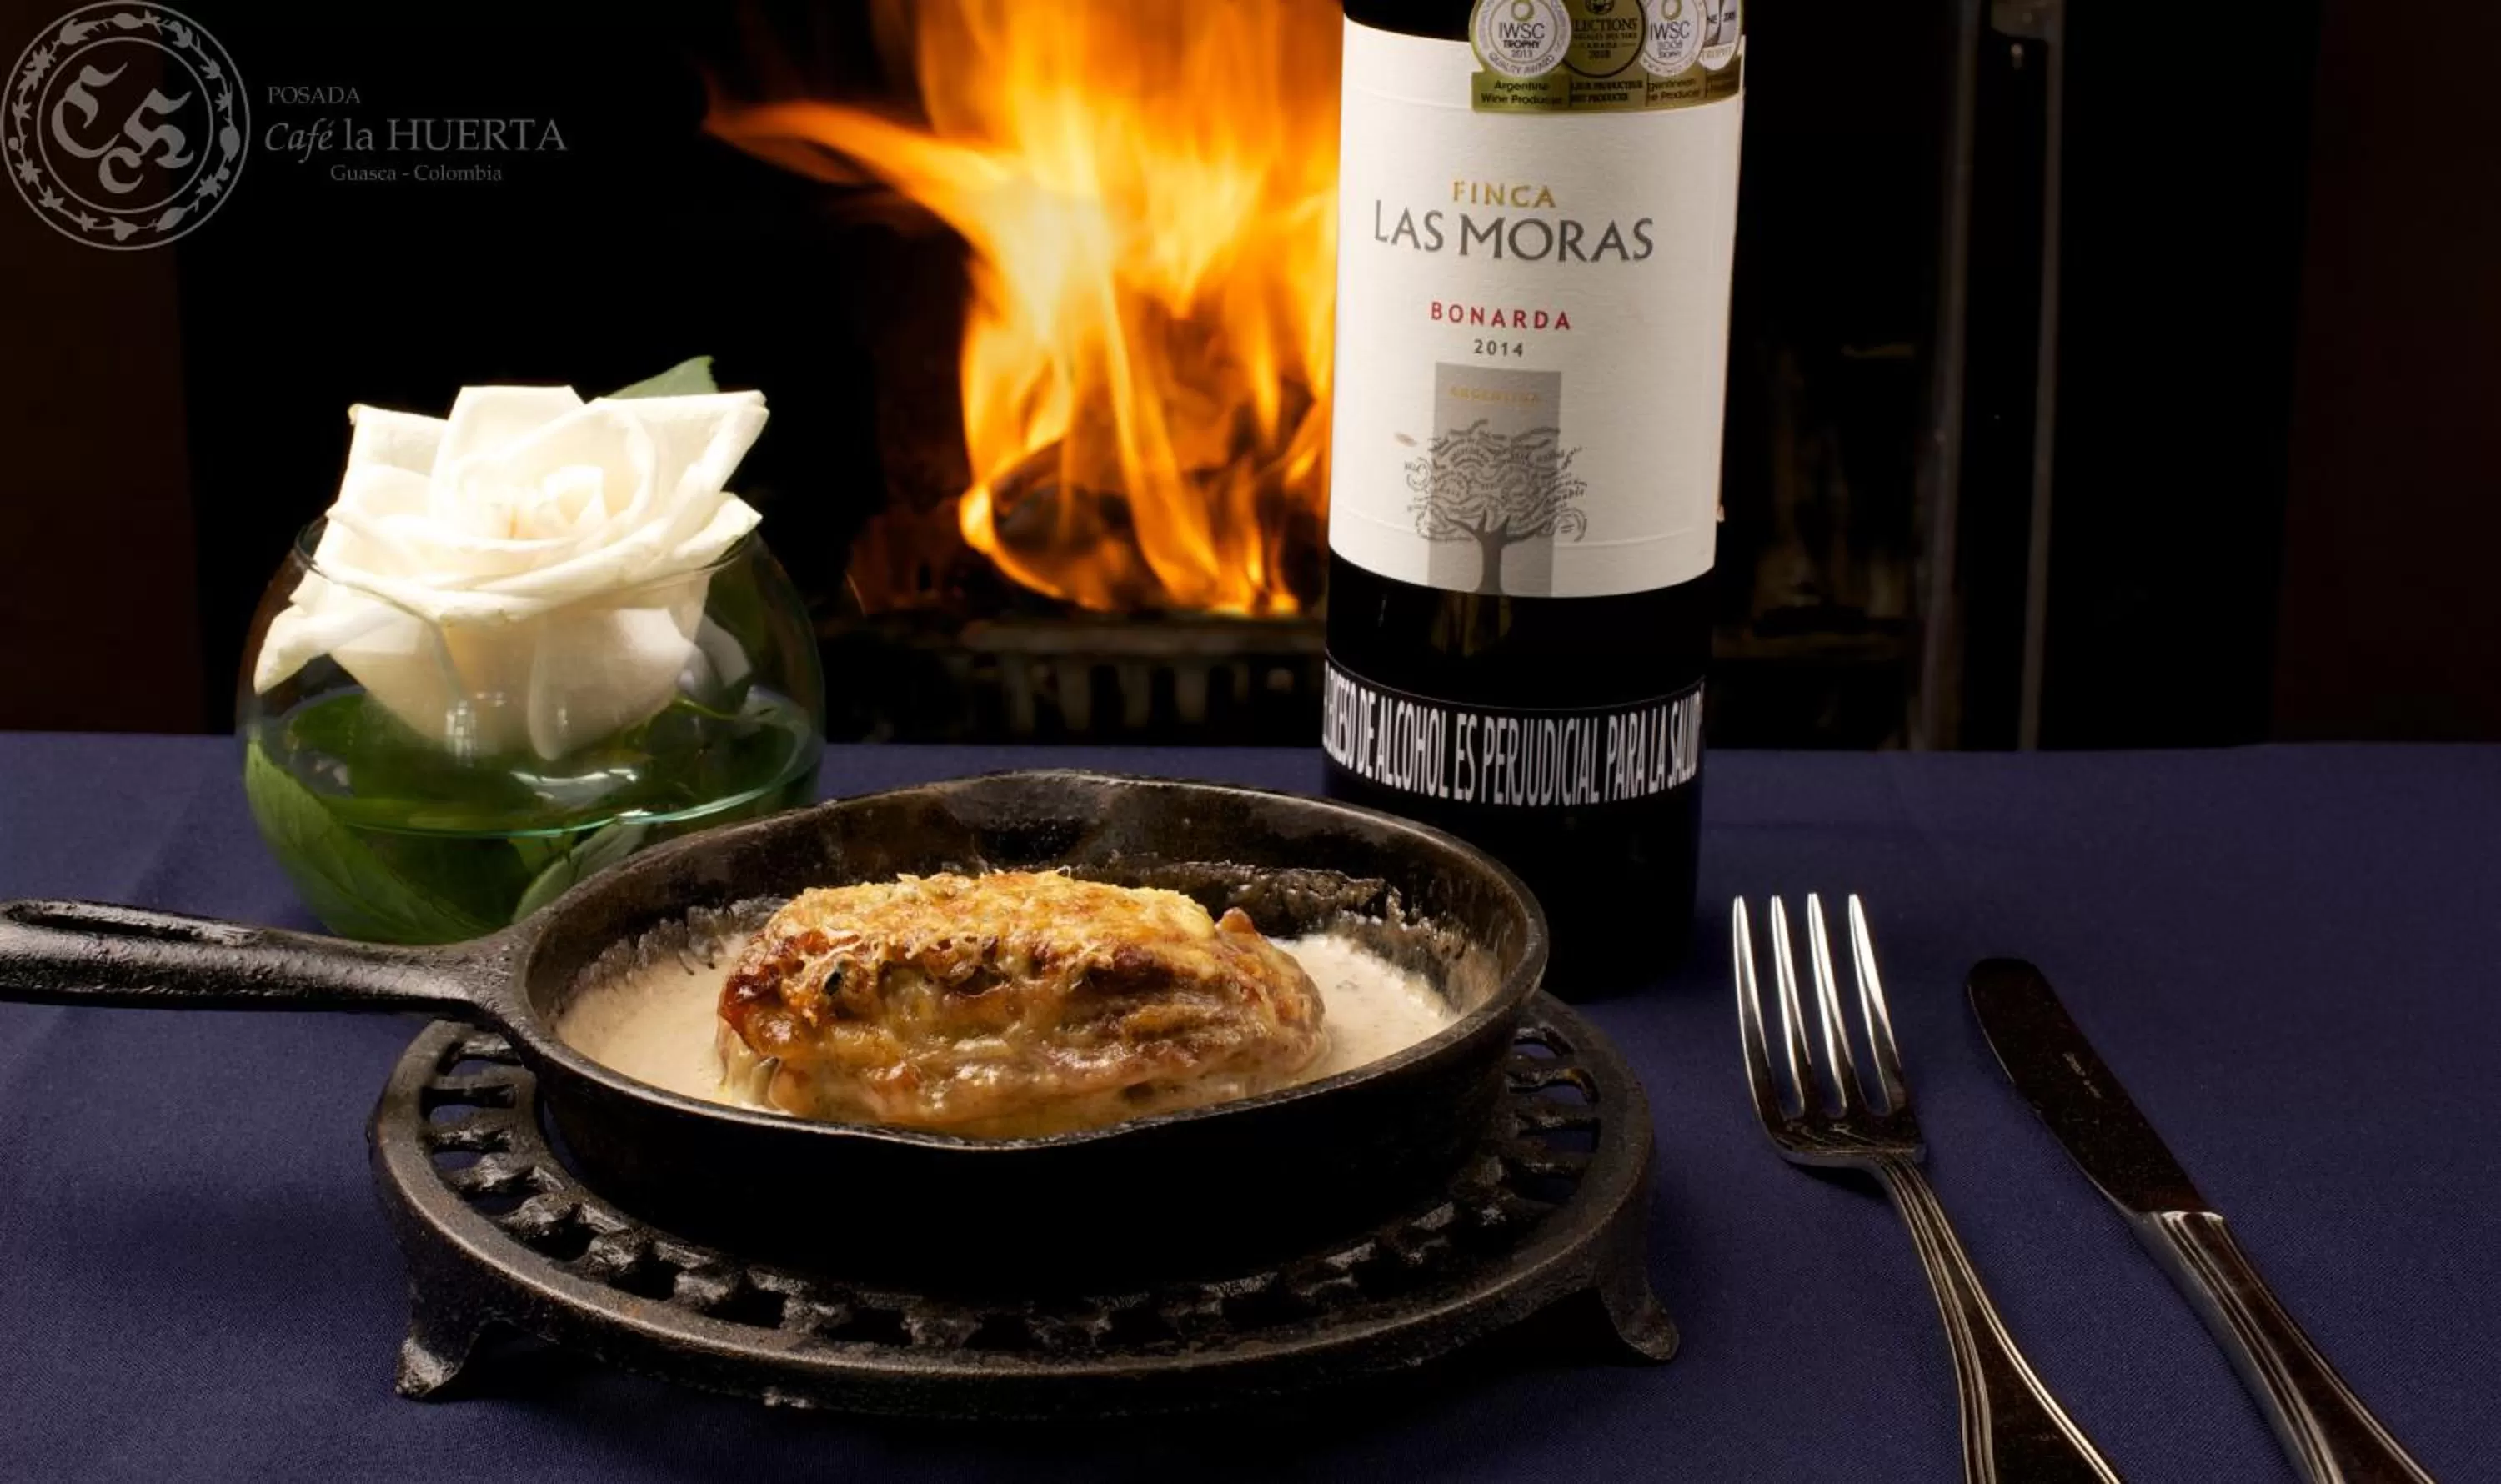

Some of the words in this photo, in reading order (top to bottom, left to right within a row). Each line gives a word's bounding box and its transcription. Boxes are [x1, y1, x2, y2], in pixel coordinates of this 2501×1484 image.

[1498, 23, 1545, 39] IWSC
[1650, 20, 1690, 40] IWSC
[1503, 39, 1540, 48] TROPHY
[1452, 180, 1556, 208] FINCA
[1375, 199, 1444, 252] LAS
[1459, 213, 1654, 263] MORAS
[1431, 301, 1571, 330] BONARDA
[1473, 339, 1524, 358] 2014
[1356, 686, 1376, 779] DE
[1375, 694, 1449, 799] ALCOHOL
[1454, 712, 1478, 803] ES
[1481, 715, 1599, 807] PERJUDICIAL
[1604, 709, 1646, 804] PARA
[1648, 704, 1667, 795] LA
